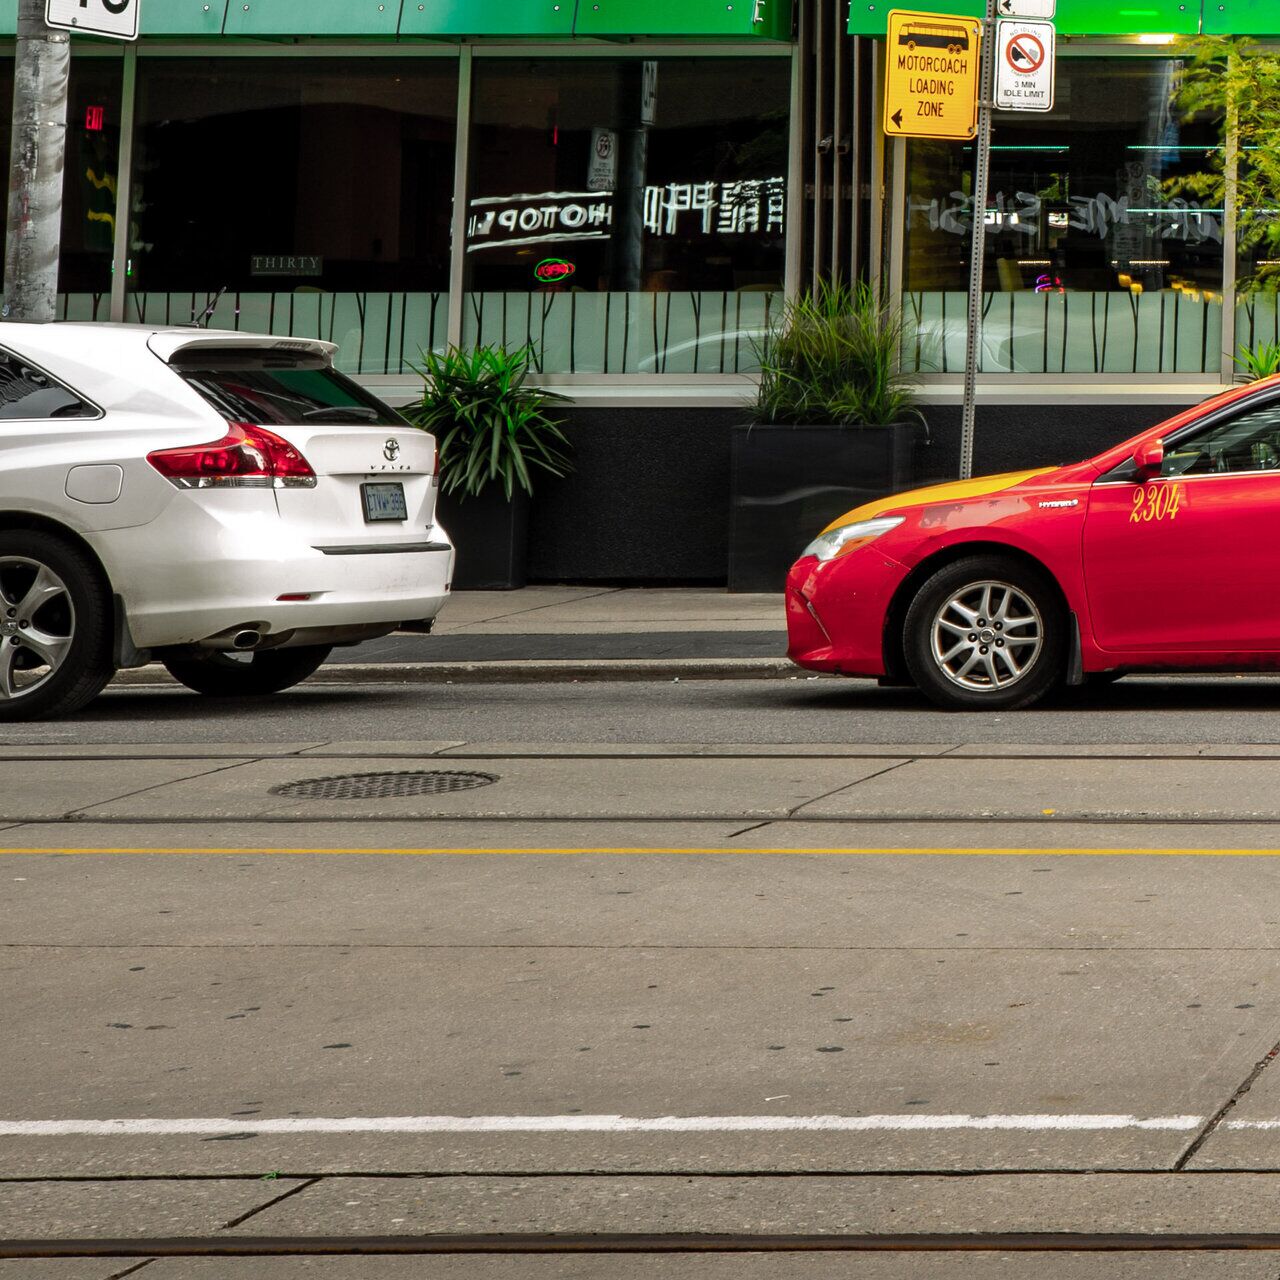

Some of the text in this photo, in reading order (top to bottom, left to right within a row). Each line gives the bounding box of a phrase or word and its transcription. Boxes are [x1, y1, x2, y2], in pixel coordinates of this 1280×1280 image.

[1009, 26, 1043, 39] NO IDLING
[897, 54, 968, 75] MOTORCOACH
[909, 78, 955, 97] LOADING
[1014, 80, 1036, 89] 3 MIN
[1003, 89, 1045, 99] IDLE LIMIT
[917, 101, 945, 119] ZONE
[252, 256, 319, 269] THIRTY
[1129, 483, 1181, 523] 2304
